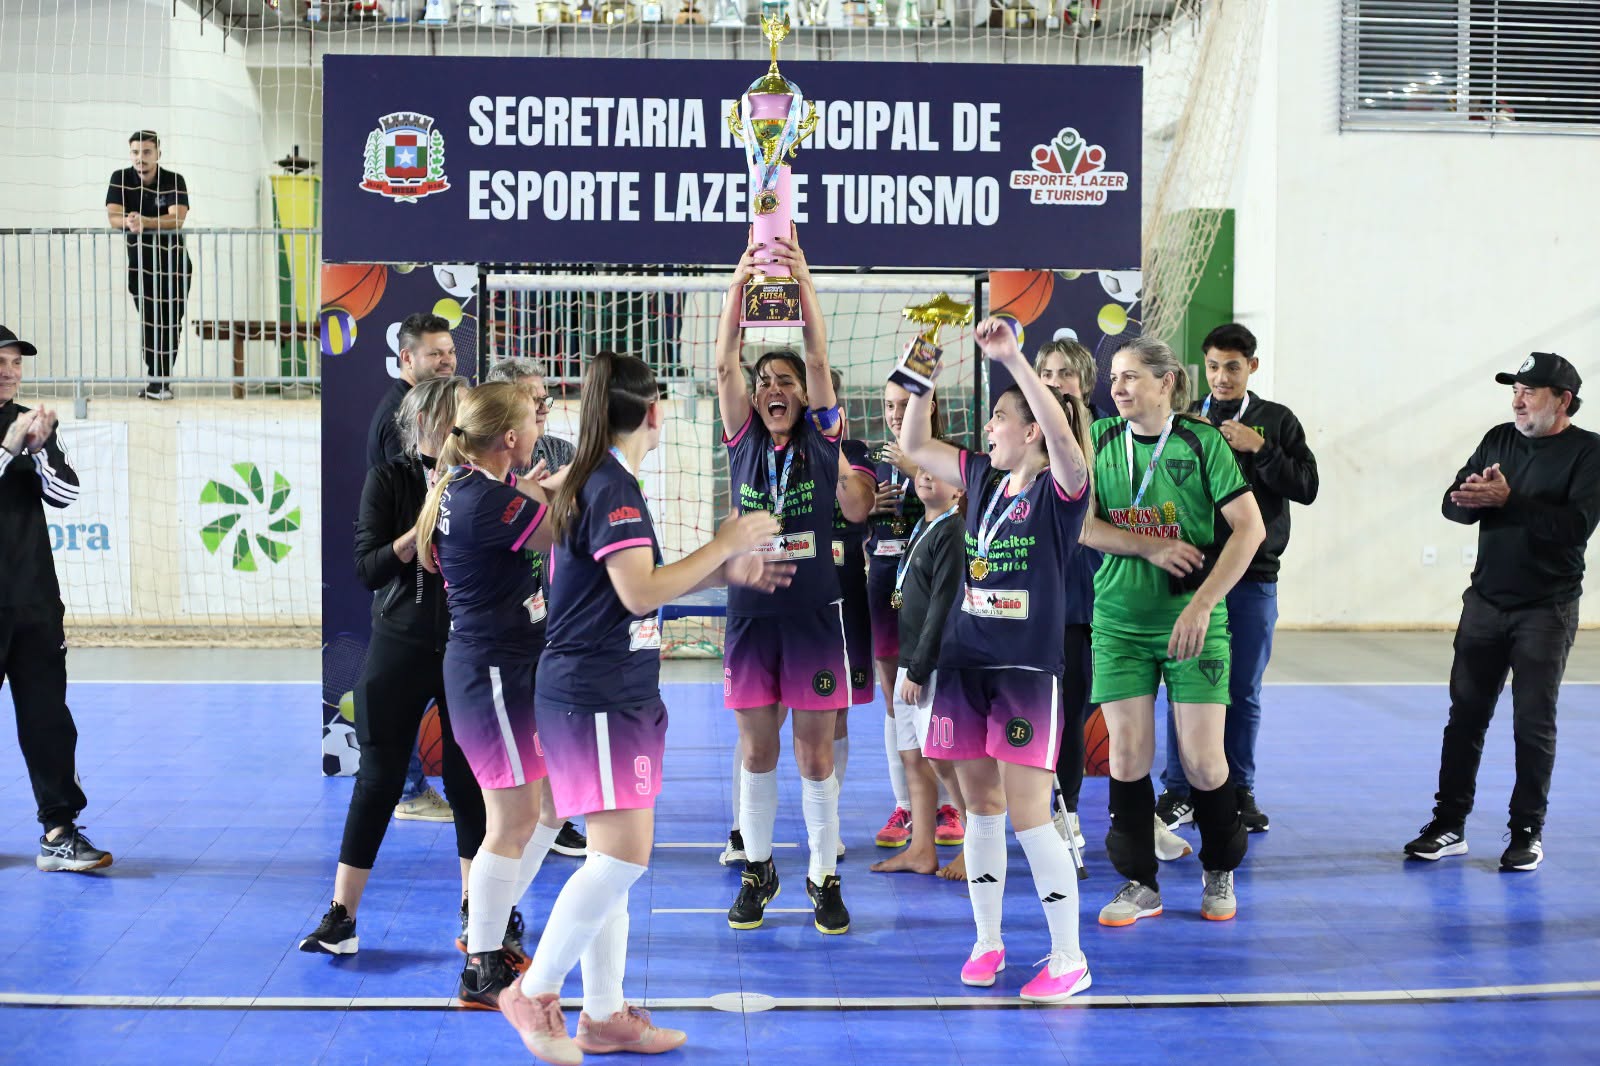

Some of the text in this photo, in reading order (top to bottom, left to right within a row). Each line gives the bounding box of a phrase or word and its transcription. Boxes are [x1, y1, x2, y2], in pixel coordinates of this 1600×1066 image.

[468, 95, 706, 148] SECRETARIA
[953, 102, 1001, 152] DE
[469, 169, 1000, 226] ESPORTE LAZE E TURISMO
[1013, 174, 1125, 187] ESPORTE, LAZER
[1034, 189, 1104, 202] E TURISMO
[760, 291, 786, 299] FUTSAL
[931, 714, 955, 749] 10
[634, 755, 652, 795] 9
